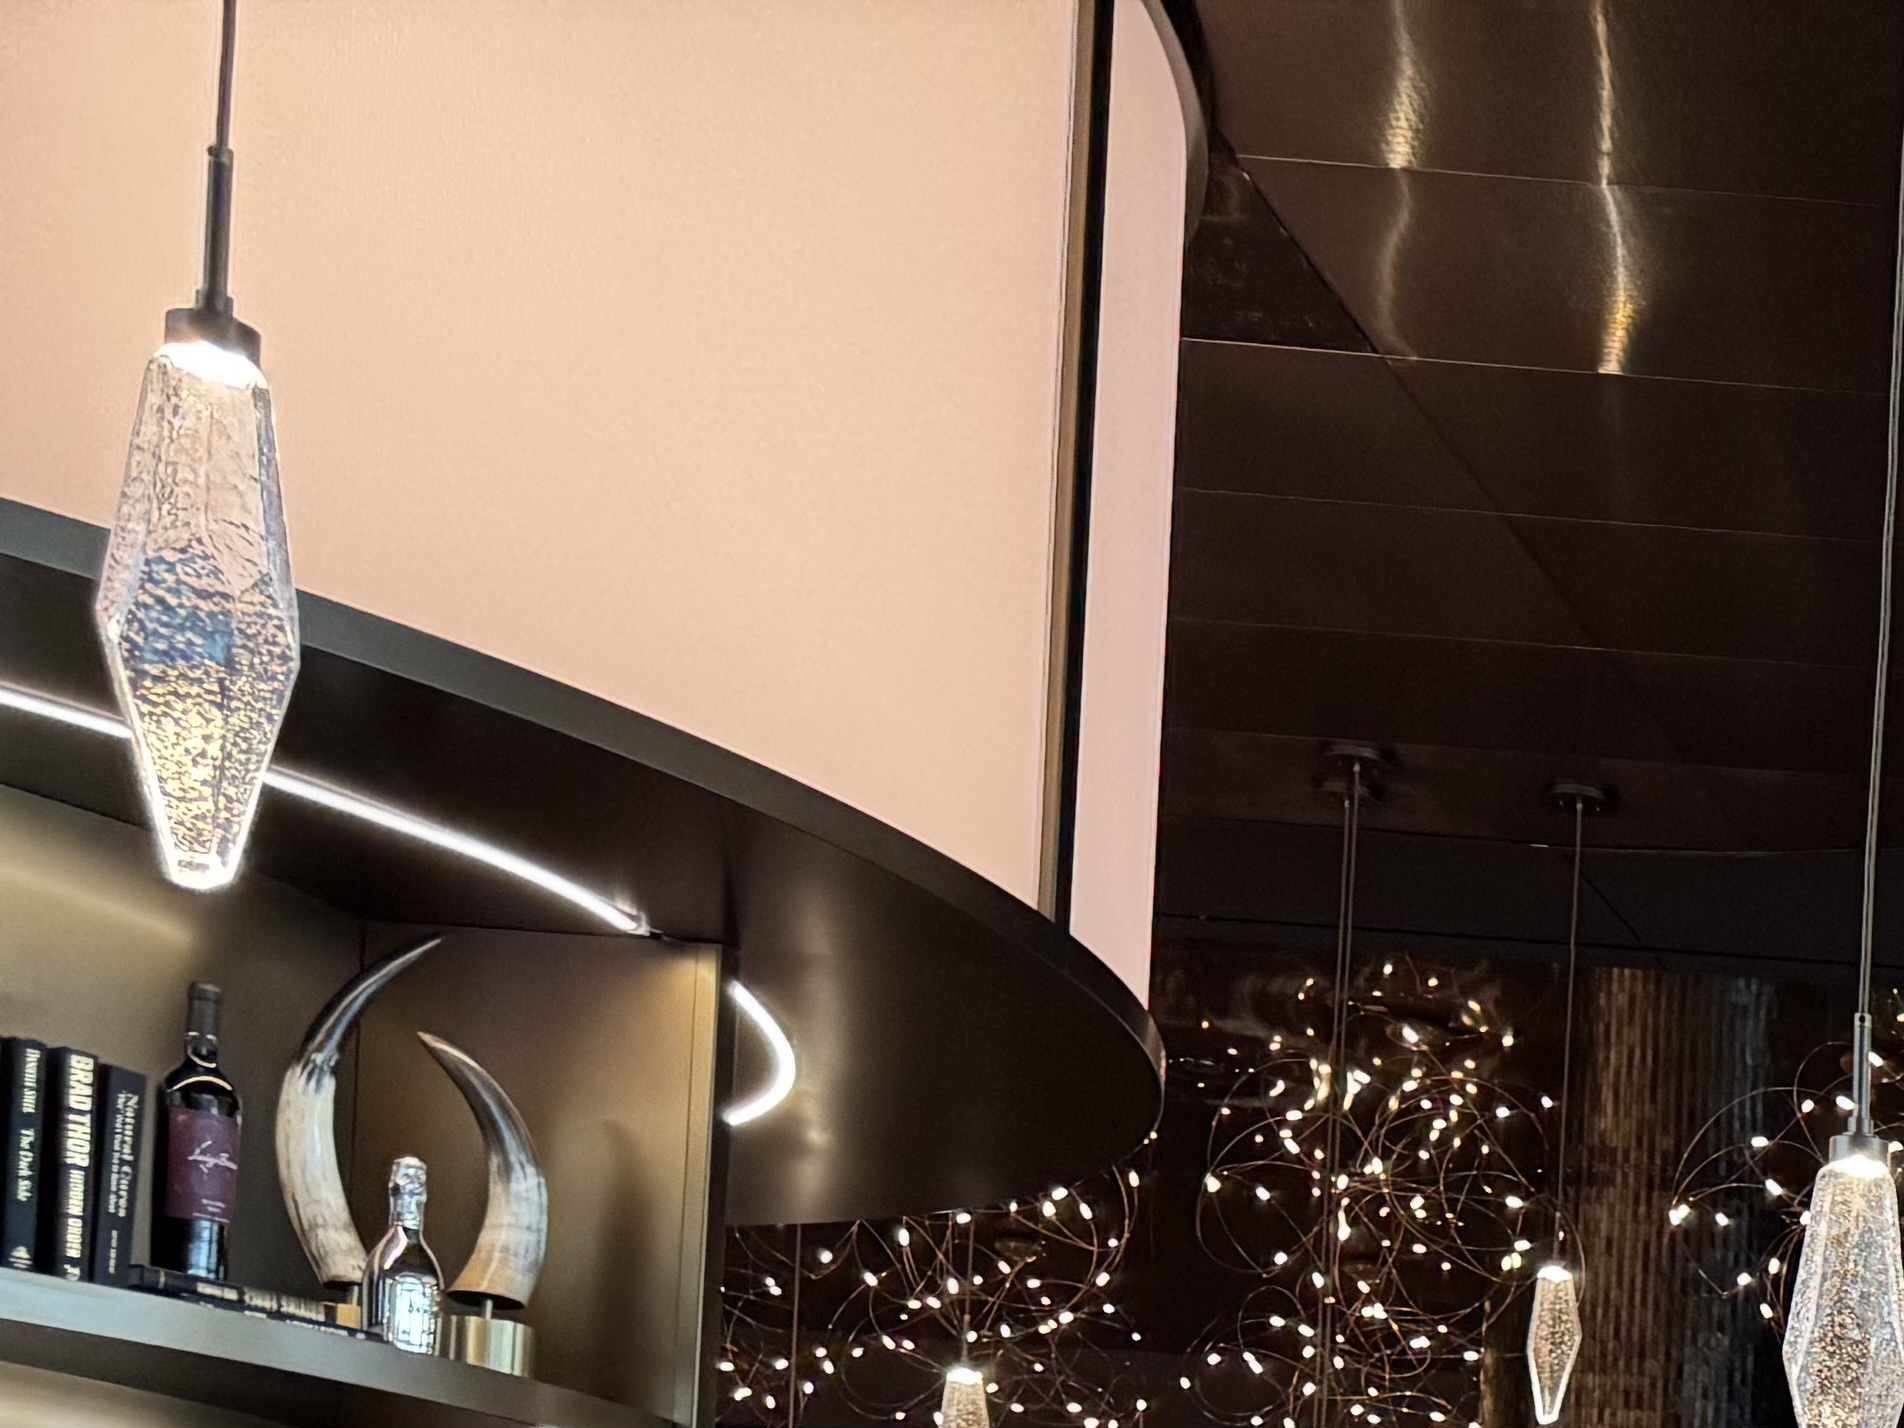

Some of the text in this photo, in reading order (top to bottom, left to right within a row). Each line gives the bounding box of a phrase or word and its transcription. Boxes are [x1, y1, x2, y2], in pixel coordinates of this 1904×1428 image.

[65, 1054, 94, 1168] BRAD THOR
[16, 1128, 35, 1202] The Dark Side
[65, 1218, 82, 1259] ORDER
